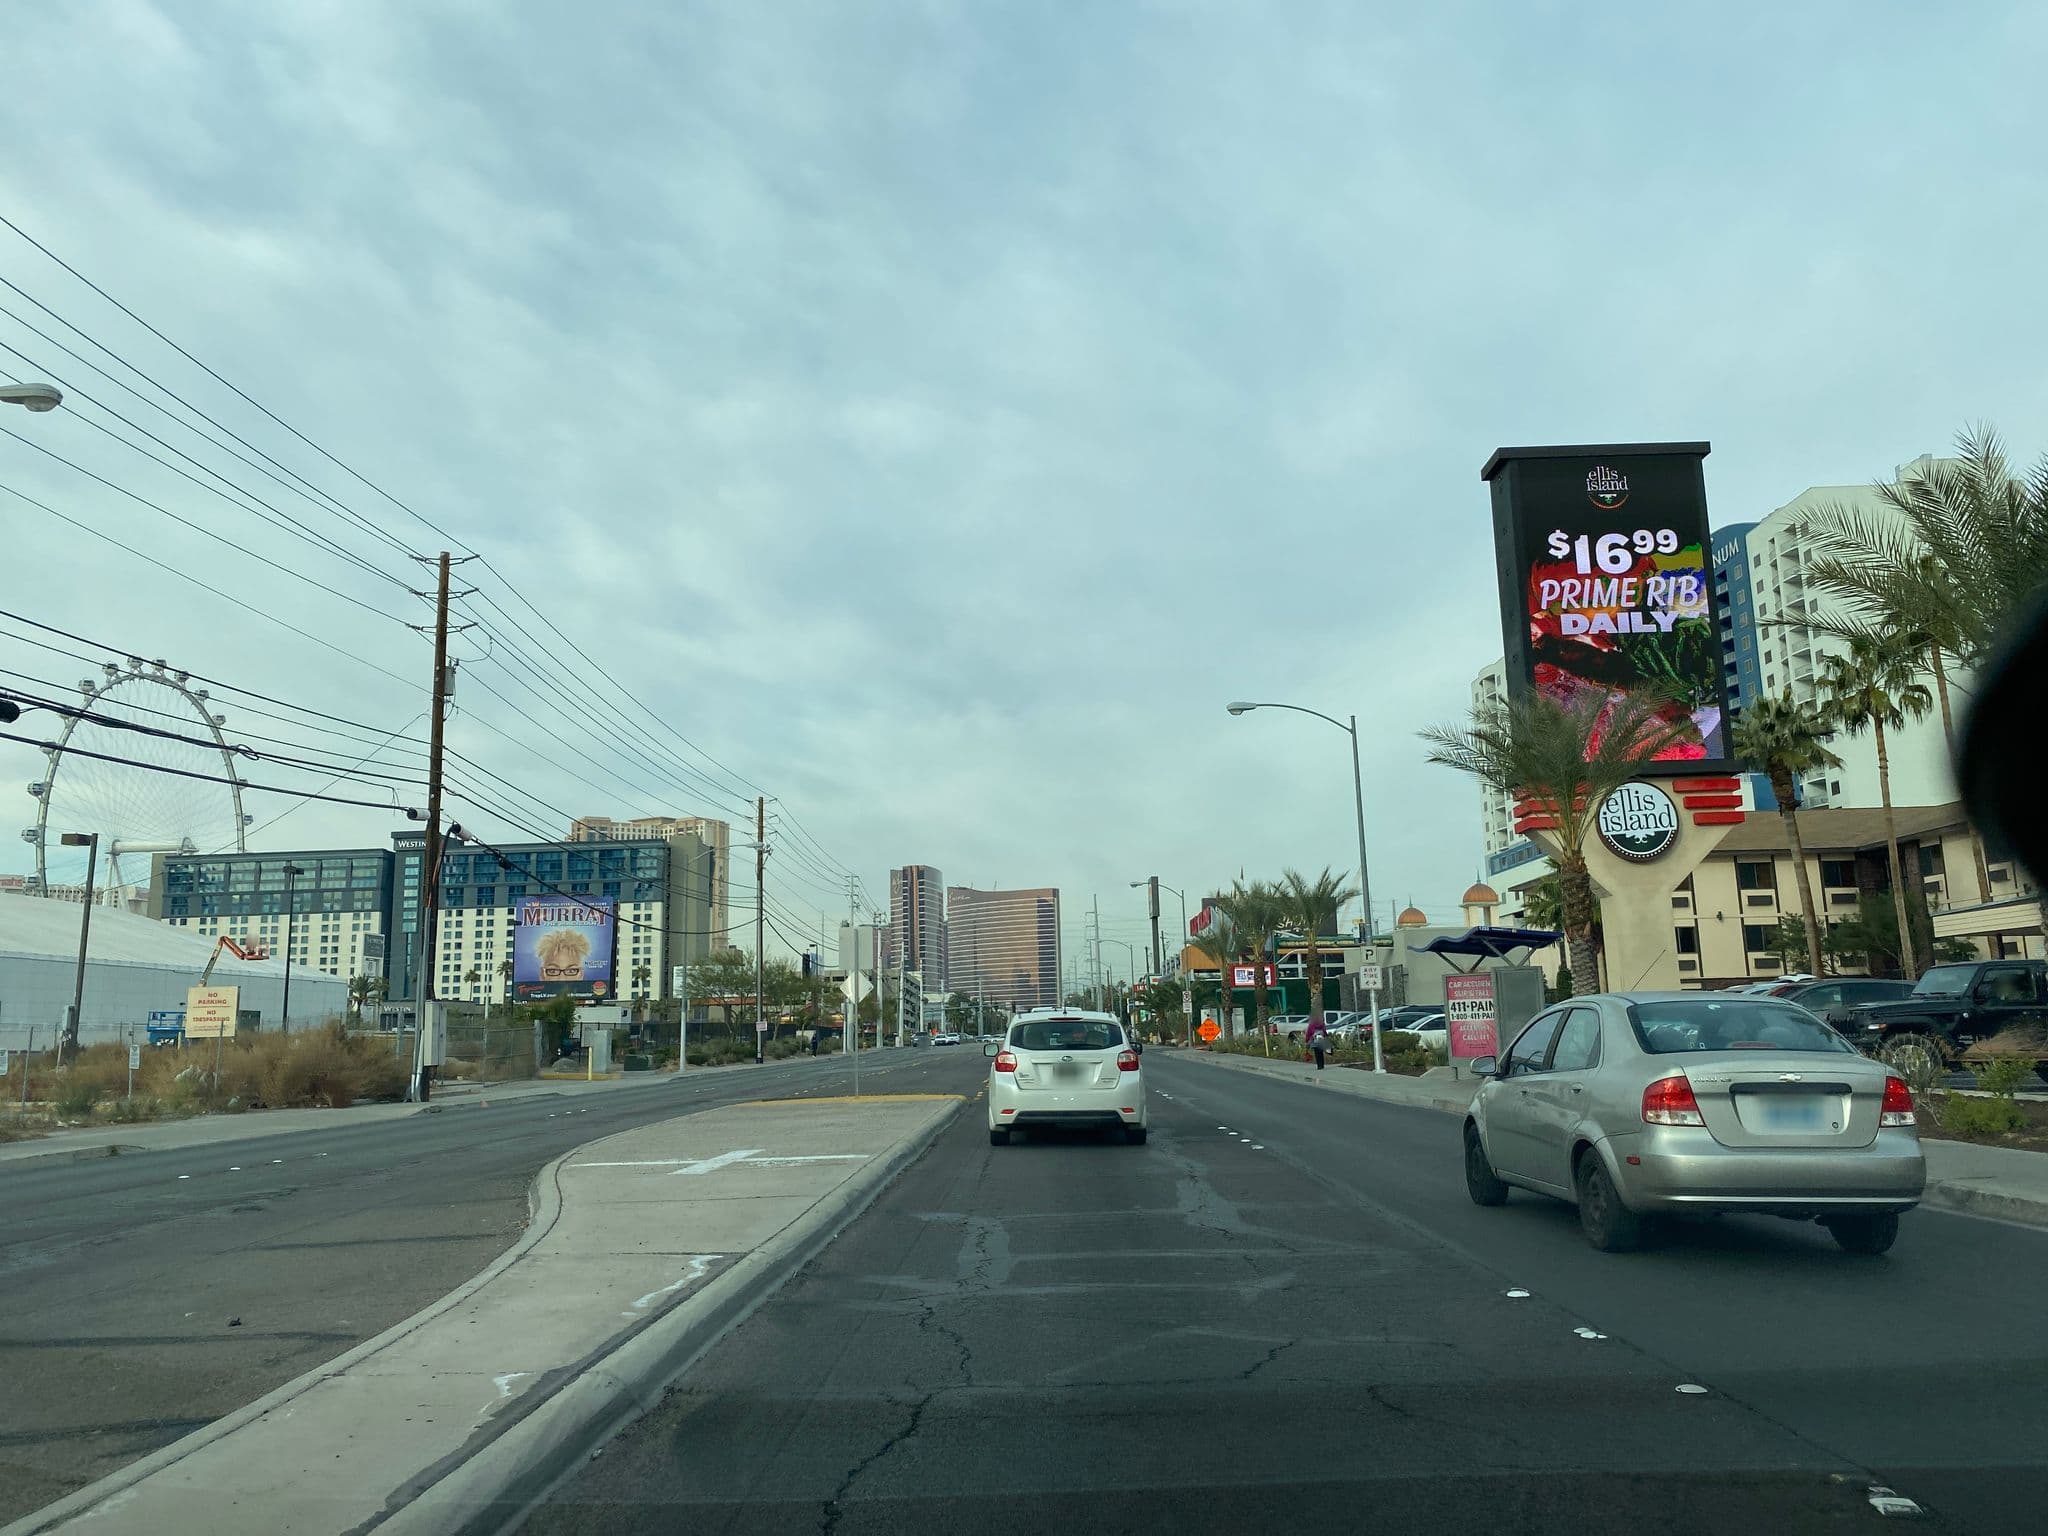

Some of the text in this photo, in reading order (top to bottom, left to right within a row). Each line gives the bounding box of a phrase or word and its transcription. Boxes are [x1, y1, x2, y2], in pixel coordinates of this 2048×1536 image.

[1586, 475, 1629, 491] island
[1588, 466, 1618, 481] ellis
[1539, 575, 1700, 610] PRIME RIB
[1560, 610, 1680, 635] DAILY
[1605, 788, 1656, 814] ellis
[1602, 803, 1675, 833] island
[398, 840, 427, 849] WESTIN
[521, 906, 611, 928] MURRAY
[1365, 949, 1374, 961] P
